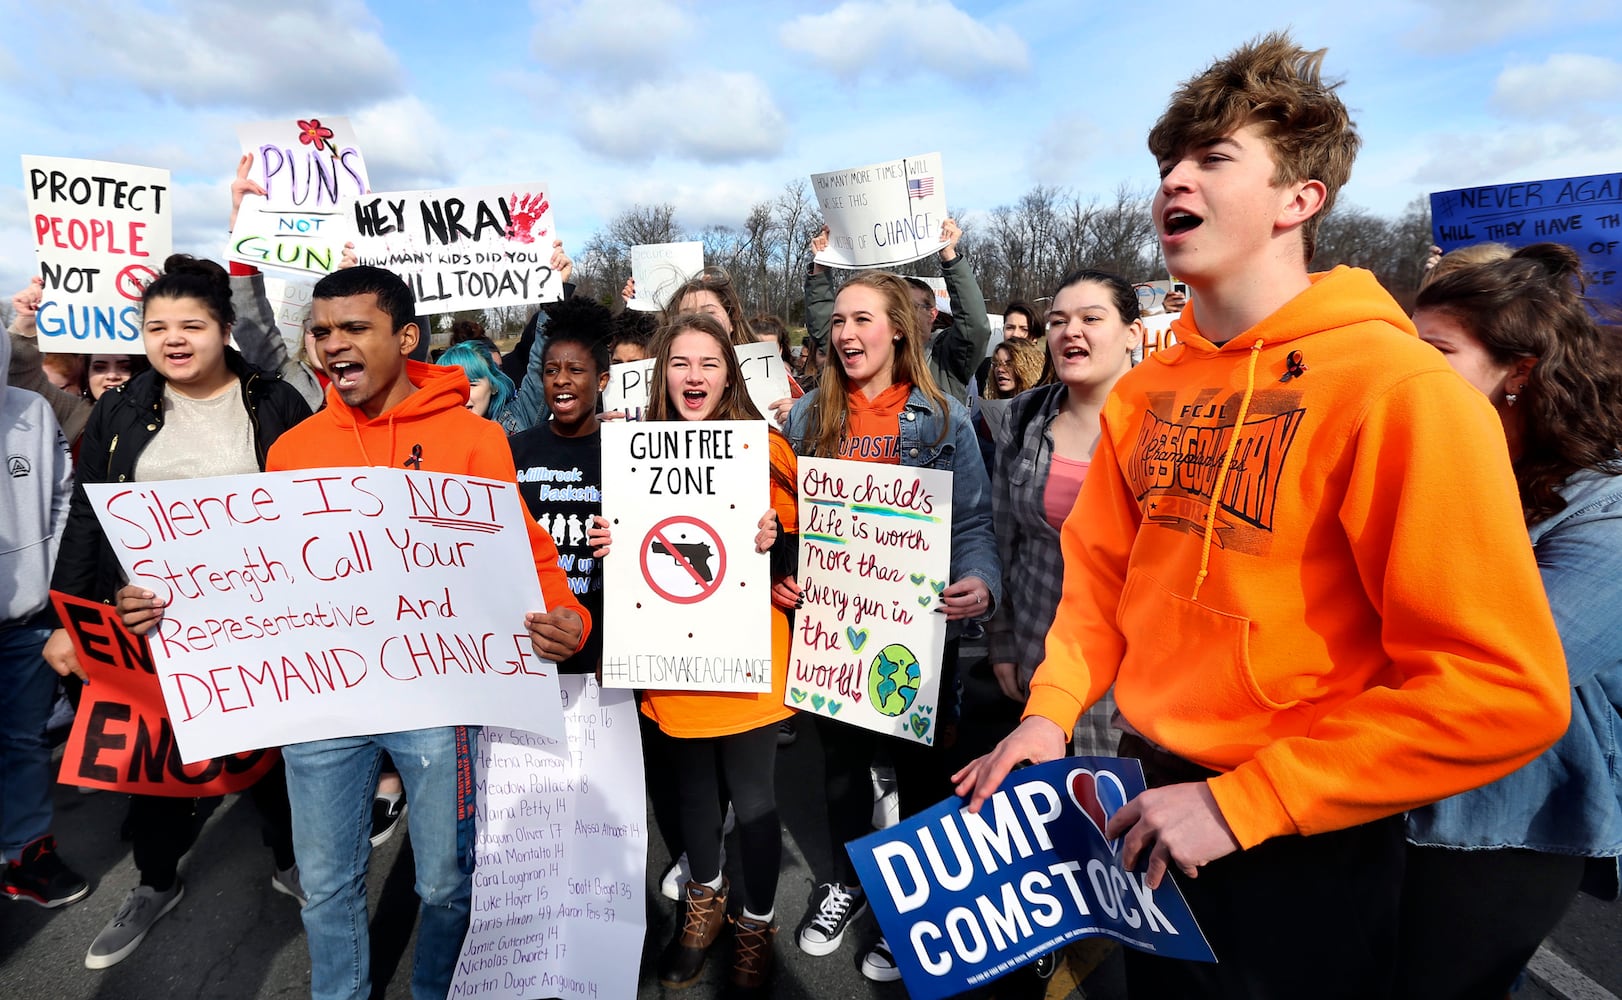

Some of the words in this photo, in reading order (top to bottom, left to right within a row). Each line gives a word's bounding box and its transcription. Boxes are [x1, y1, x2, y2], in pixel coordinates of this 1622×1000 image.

[260, 143, 368, 206] PUNS
[817, 177, 829, 189] HOW
[830, 175, 848, 187] MANY
[850, 170, 872, 184] MORE
[875, 164, 903, 180] TIMES
[908, 160, 928, 174] WILL
[30, 168, 166, 214] PROTECT
[848, 193, 868, 207] THIS
[35, 214, 150, 257] PEOPLE
[279, 217, 325, 233] NOT
[354, 198, 406, 237] HEY
[420, 197, 515, 246] NRA!
[1440, 224, 1476, 242] WILL
[1484, 219, 1526, 238] THEY
[1535, 214, 1583, 237] HAVE
[858, 234, 867, 249] OF
[1588, 241, 1619, 255] OF
[360, 255, 387, 267] HOW
[390, 252, 433, 265] MANY
[439, 251, 472, 264] KIDS
[476, 251, 501, 264] DID
[506, 250, 538, 264] YOU
[41, 261, 100, 293] NOT
[399, 273, 452, 302] ILL
[454, 266, 552, 299] TODAY?
[36, 301, 140, 341] GUNS
[630, 430, 679, 460] GUN
[685, 429, 734, 460] FREE
[517, 466, 583, 482] Millbrook
[649, 466, 717, 496] ZONE
[803, 468, 848, 500] One
[853, 474, 934, 515] child's
[106, 487, 281, 551] Silence
[292, 476, 385, 517] IS
[404, 474, 506, 523] NOT
[805, 505, 845, 537] life
[851, 515, 868, 540] is
[875, 524, 930, 551] worth
[132, 546, 296, 608] Strength,
[301, 530, 373, 582] Call
[384, 527, 476, 572] Your
[805, 542, 852, 573] more
[857, 554, 906, 583] than
[803, 576, 849, 622] every
[853, 592, 888, 625] gun
[891, 600, 914, 626] in
[157, 600, 376, 659] Representative
[395, 587, 458, 621] And
[799, 615, 842, 651] the
[167, 647, 369, 723] DEMAND
[380, 631, 549, 682] CHANGE
[604, 655, 772, 685] #LETSMAKEACHANGE
[796, 658, 863, 704] world!
[583, 677, 599, 699] 15
[600, 709, 613, 729] 16
[477, 726, 504, 744] Alex
[585, 728, 596, 749] 14
[477, 750, 520, 769] Helena
[568, 751, 583, 769] 17
[476, 779, 525, 796] Meadow
[530, 774, 575, 793] Pollack
[580, 775, 589, 793] 18
[475, 803, 515, 822] Alaina
[520, 800, 551, 821] Petty
[556, 797, 566, 813] 14
[515, 827, 544, 842] Oliver
[550, 823, 562, 839] 17
[630, 823, 639, 838] 14
[872, 780, 1063, 915] DUMP
[475, 851, 502, 867] Gina
[506, 847, 550, 864] Montalto
[554, 844, 564, 859] 14
[474, 873, 498, 888] Cara
[502, 868, 546, 891] Loughran
[549, 863, 559, 877] 14
[474, 895, 502, 912] Luke
[505, 892, 533, 910] Hoyer
[536, 886, 549, 901] 15
[568, 877, 591, 895] Scott
[621, 882, 632, 900] 35
[471, 917, 502, 934] Chris
[506, 911, 533, 927] Hixon
[538, 905, 551, 920] 49
[556, 903, 583, 919] Aaron
[603, 907, 615, 922] 37
[909, 858, 1179, 977] COMSTOCK
[463, 939, 495, 956] Jamie
[497, 932, 544, 948] Guttenberg
[547, 925, 558, 939] 14
[457, 954, 508, 977] Nicholas
[555, 944, 567, 959] 17
[451, 978, 498, 1000] Martin
[588, 981, 597, 999] 14
